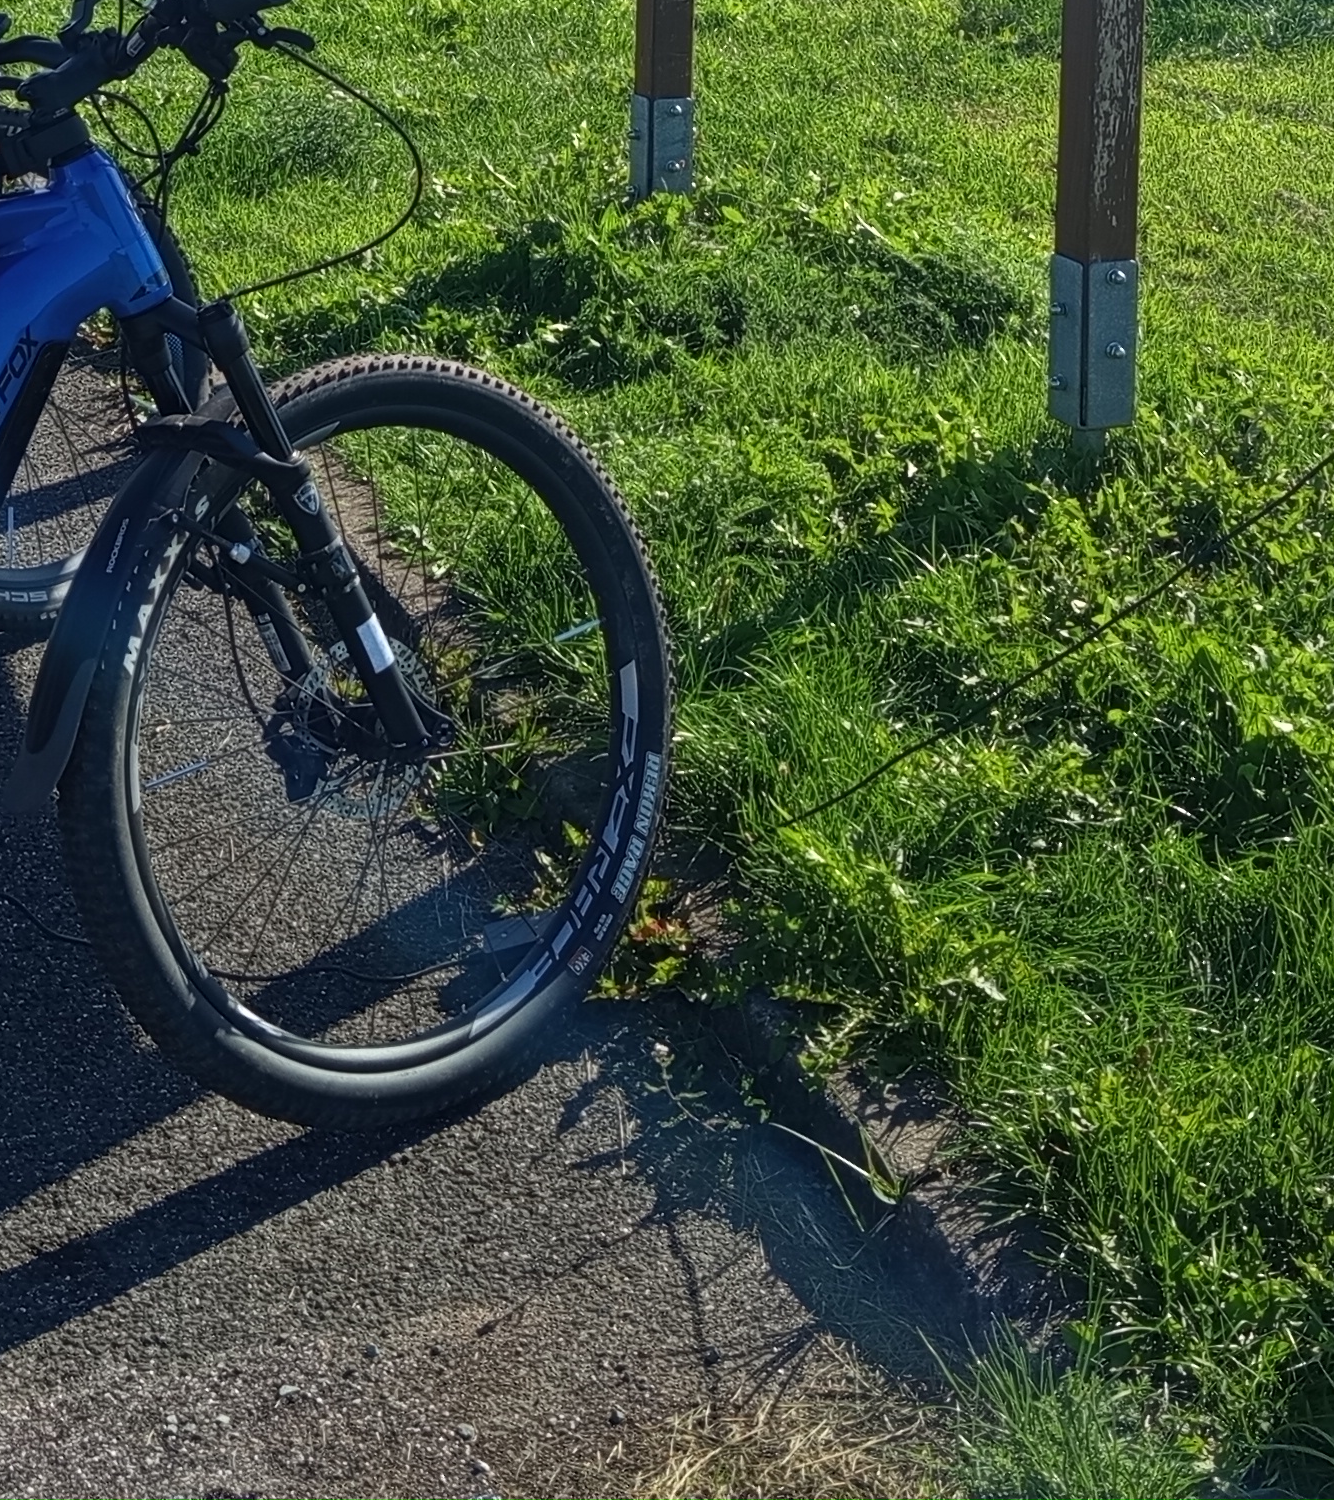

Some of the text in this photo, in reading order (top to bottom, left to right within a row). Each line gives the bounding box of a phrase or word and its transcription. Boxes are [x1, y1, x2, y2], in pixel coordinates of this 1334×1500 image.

[123, 494, 210, 676] MAXXS
[610, 750, 663, 904] REKON RACE
